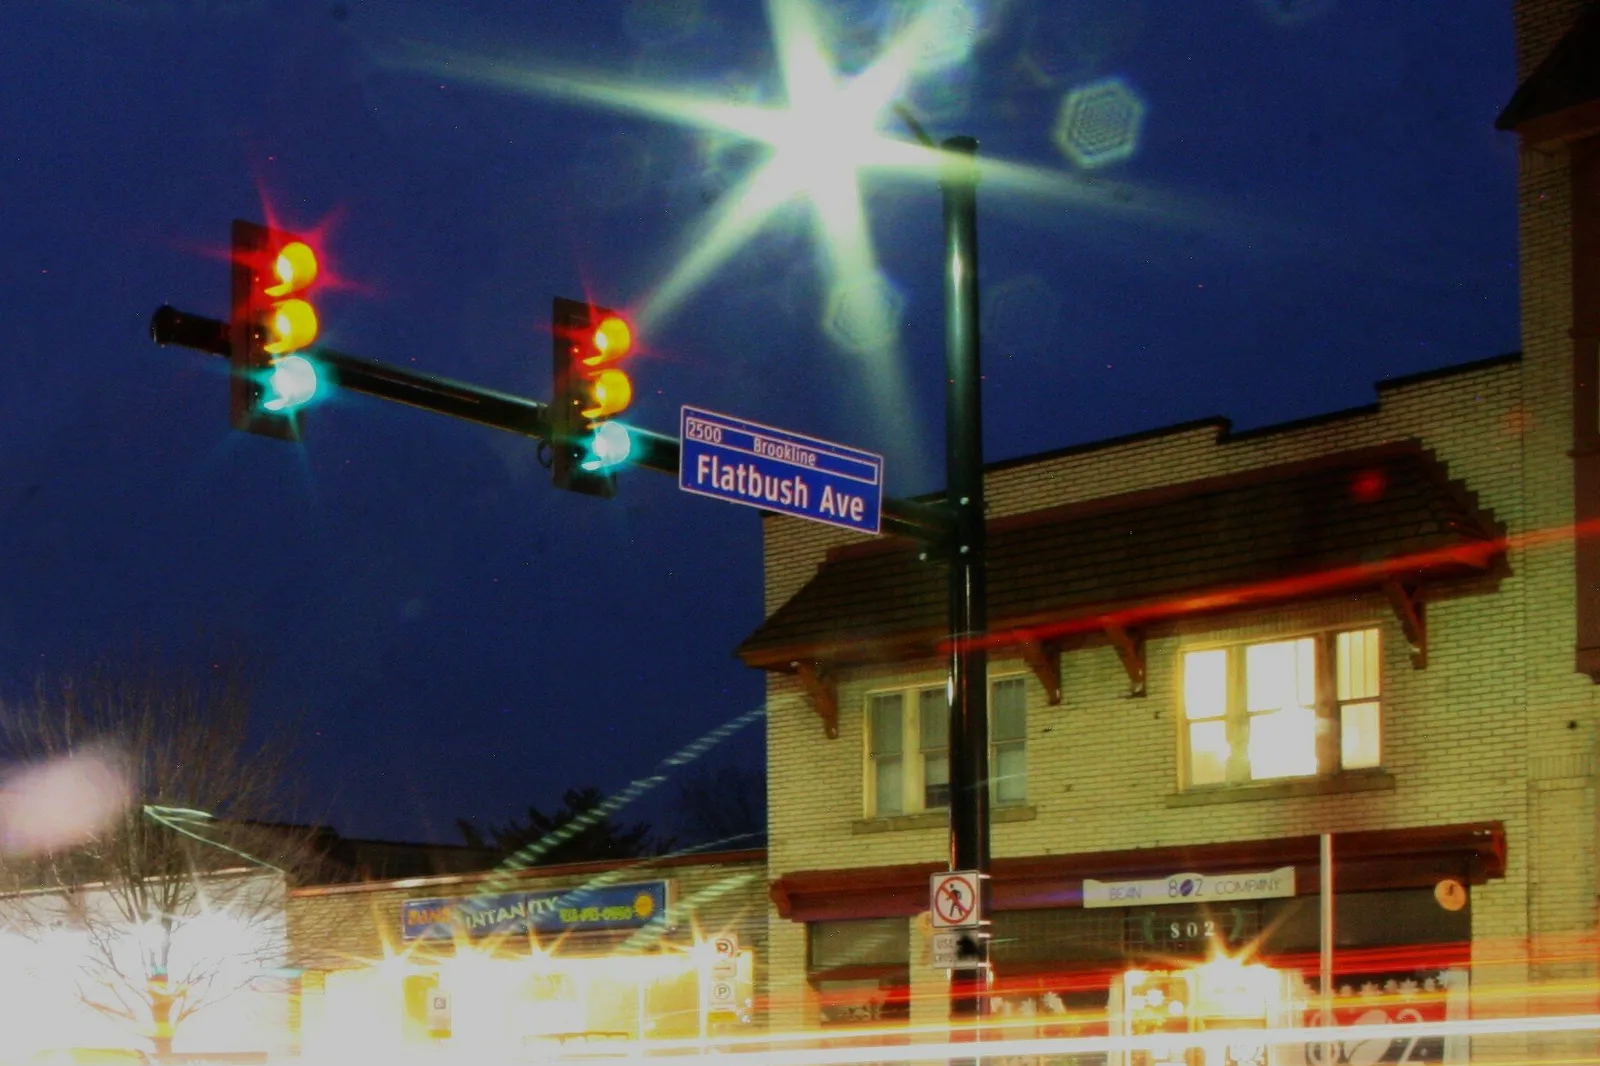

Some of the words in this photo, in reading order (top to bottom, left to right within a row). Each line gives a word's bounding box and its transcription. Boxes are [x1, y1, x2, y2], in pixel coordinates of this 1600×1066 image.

[687, 420, 722, 445] 2500
[753, 436, 817, 467] Brookline
[697, 454, 808, 509] Flatbush
[819, 485, 864, 522] Ave
[1109, 886, 1143, 901] BEAN
[1215, 877, 1283, 896] COMPANY
